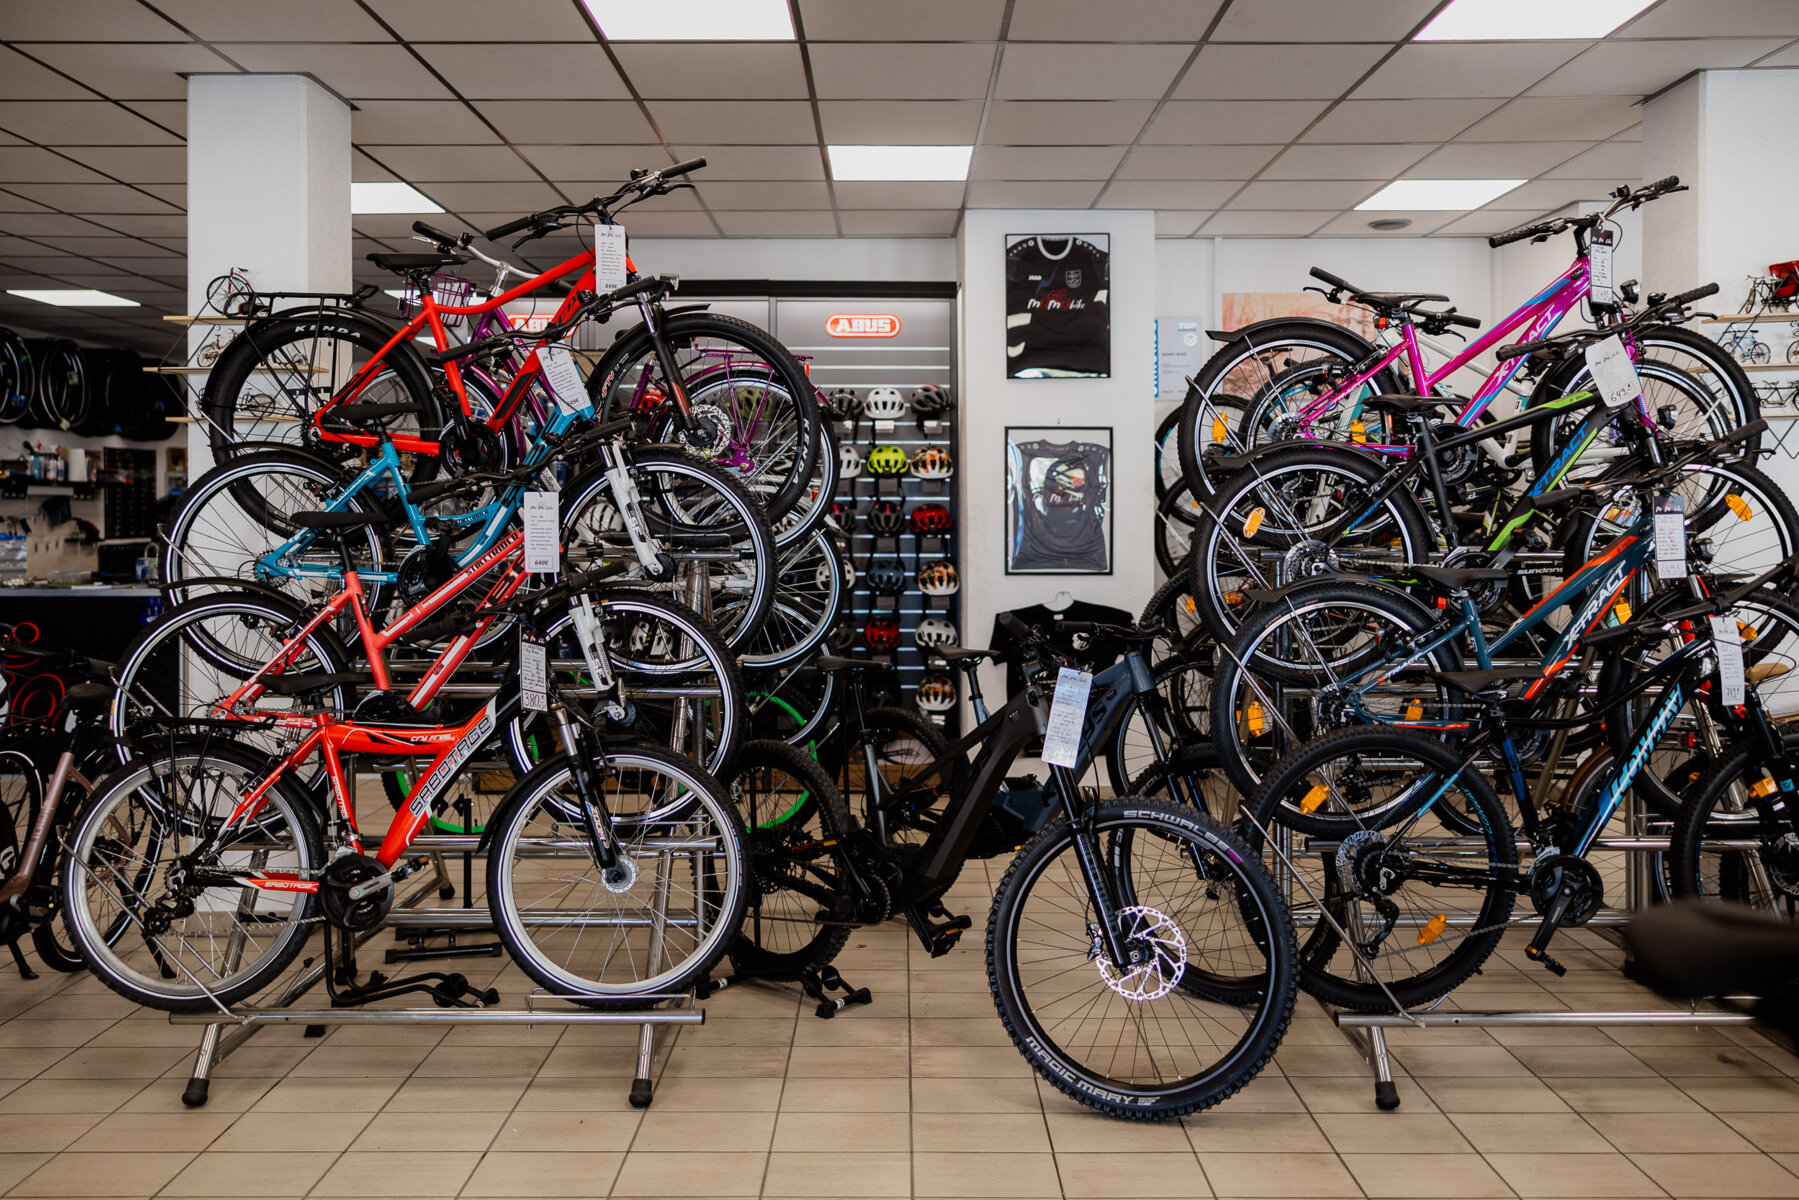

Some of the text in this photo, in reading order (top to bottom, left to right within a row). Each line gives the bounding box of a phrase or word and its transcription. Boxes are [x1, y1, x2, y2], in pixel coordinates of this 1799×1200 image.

[295, 324, 360, 338] KENDA
[836, 318, 891, 333] ABUS
[793, 418, 809, 484] KENDA
[409, 715, 494, 817] SABOTAGE
[331, 775, 349, 820] SABOTAG
[590, 805, 607, 841] ZOOM
[1124, 810, 1230, 852] SCHWALBE
[264, 881, 313, 889] SABOTAGE
[1025, 1036, 1134, 1104] MAGIC MARY
